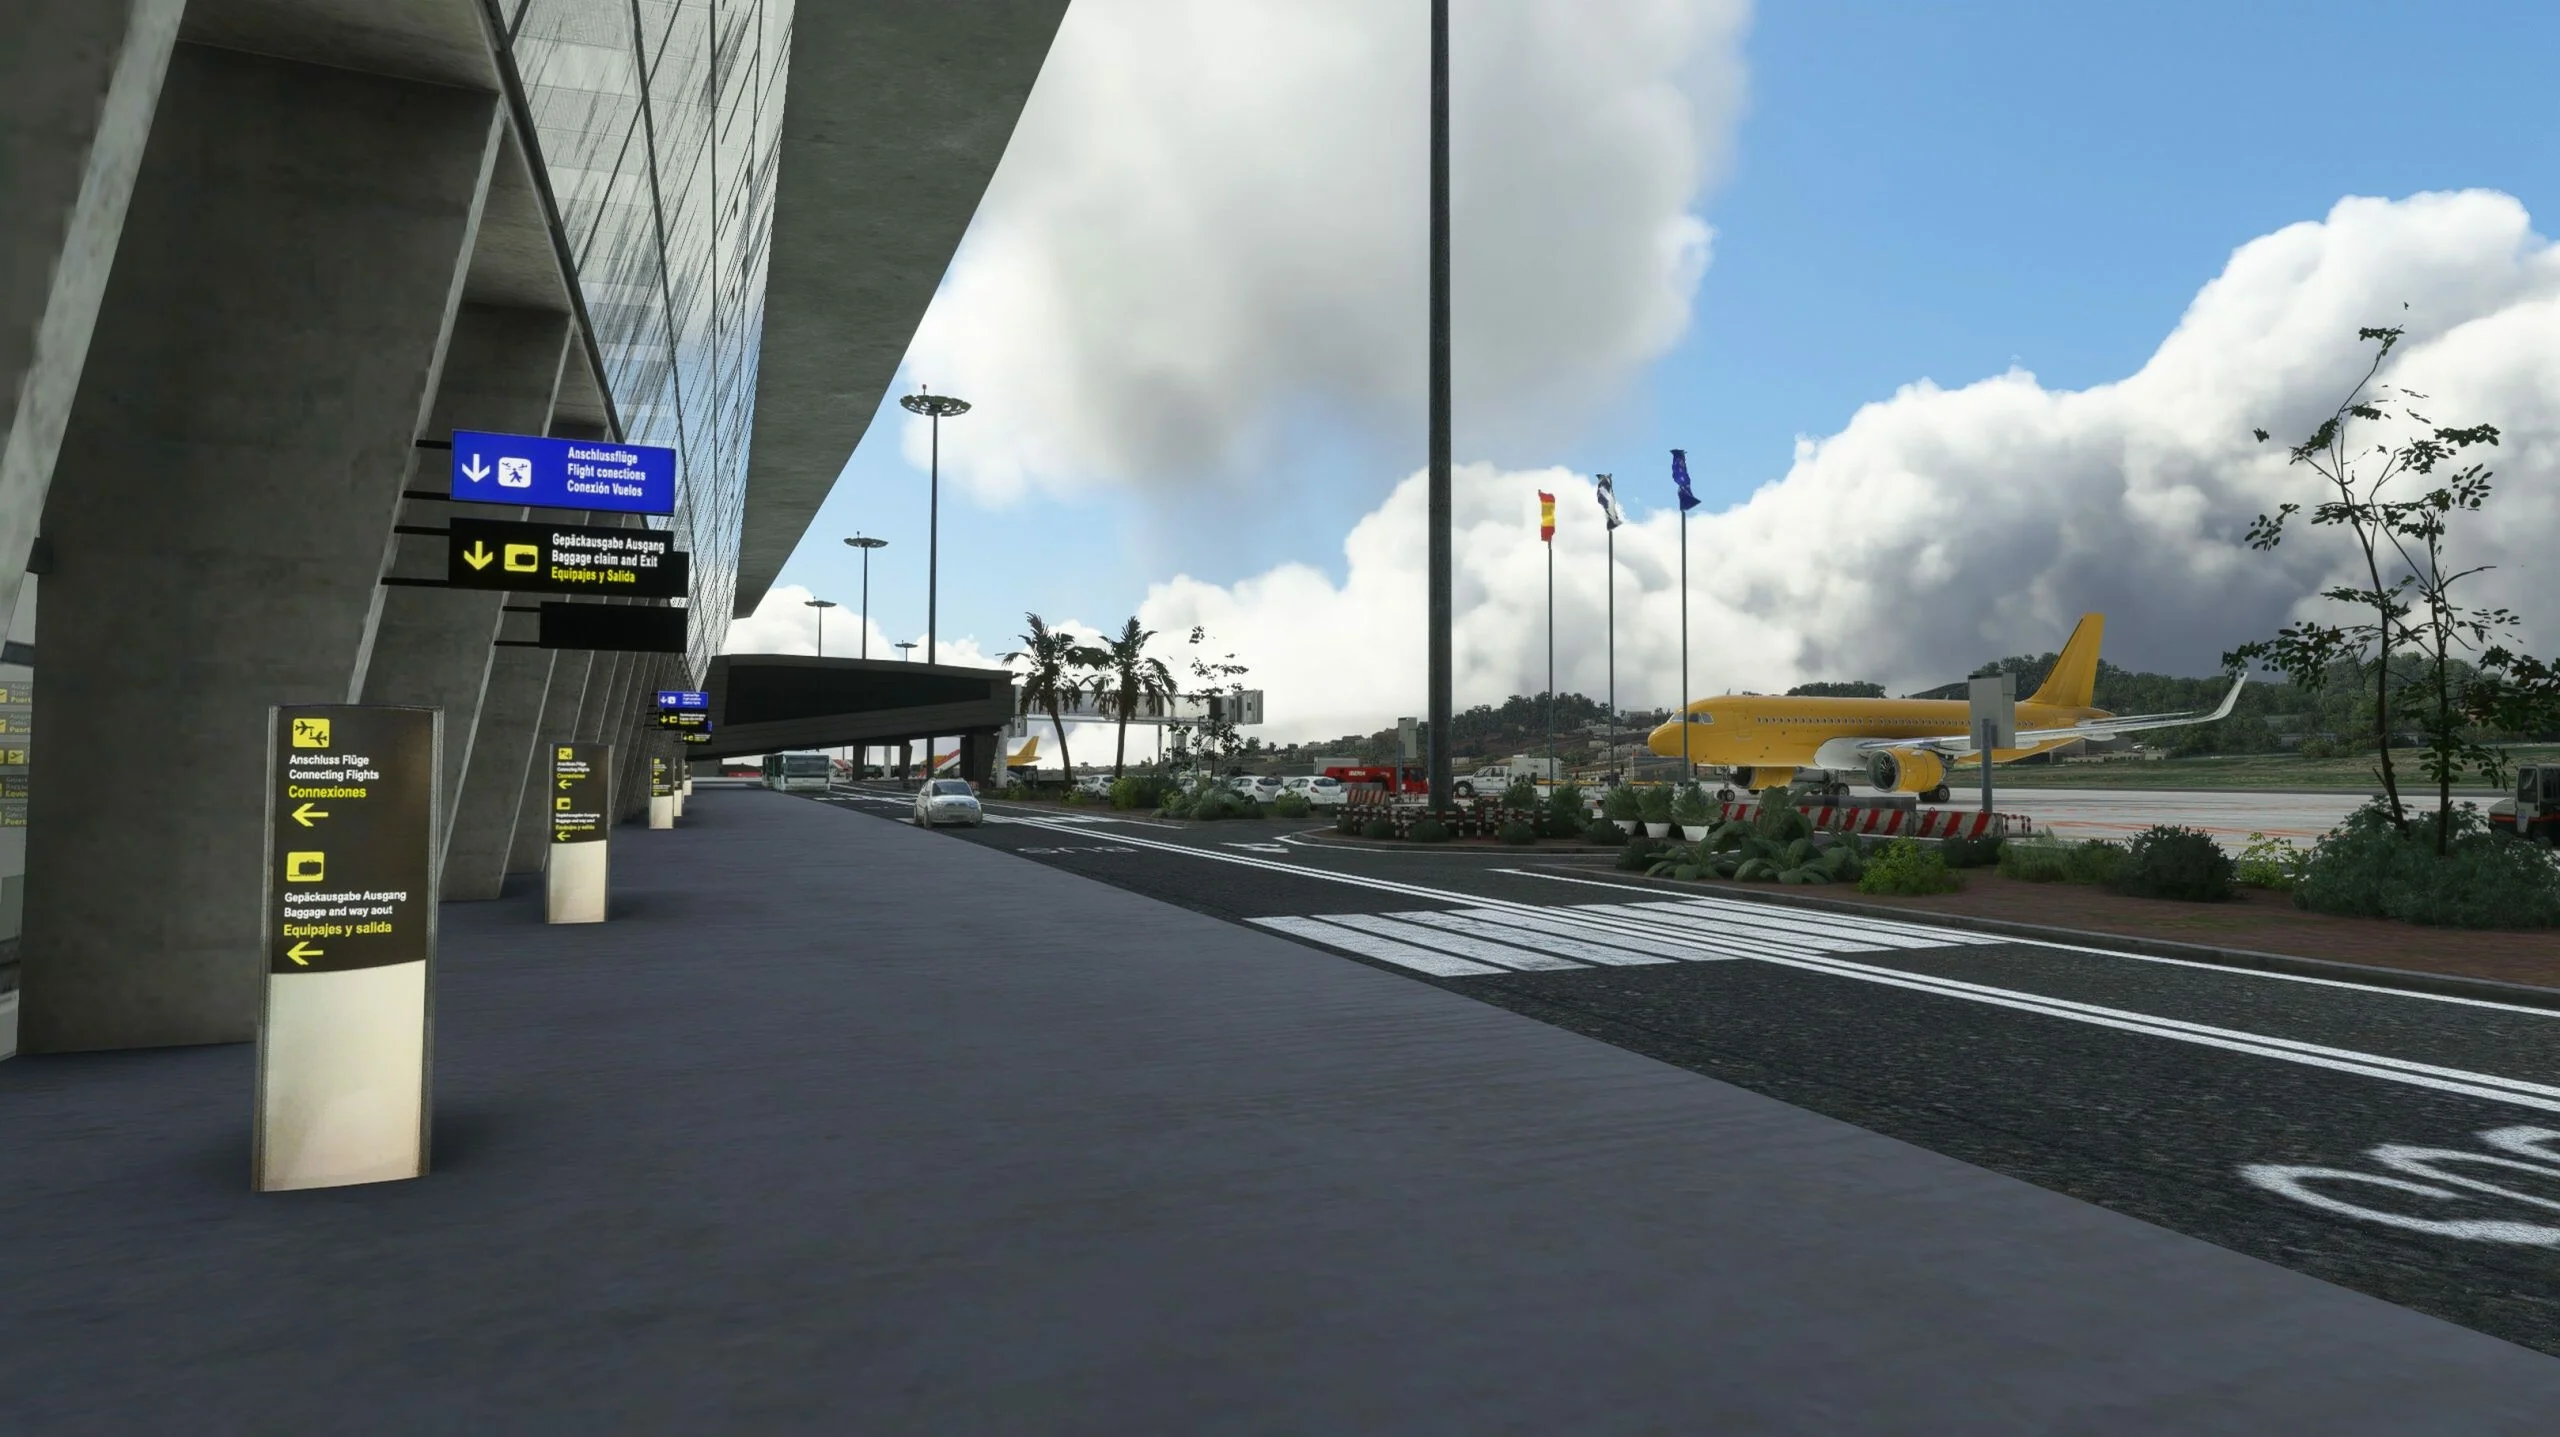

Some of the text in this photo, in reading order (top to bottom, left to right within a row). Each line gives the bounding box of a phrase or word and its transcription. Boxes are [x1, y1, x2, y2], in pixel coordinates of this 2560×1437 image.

[567, 446, 638, 466] Anschlussflüge
[567, 463, 646, 481] Flight conections
[567, 479, 643, 497] Conexión Vuelos
[552, 533, 665, 554] Gepäckausgabe Ausgang
[552, 549, 658, 568] Baggage claim and Exit
[551, 566, 636, 584] Equipajes y Salida
[289, 754, 370, 767] Anschluss Flüge
[289, 769, 380, 782] Connecting Flights
[288, 785, 367, 798] Connexiones
[284, 890, 407, 904] Gepäckausgabe Ausgang
[284, 905, 393, 919] Baggage and way aout
[283, 921, 392, 938] Equipajes y salida
